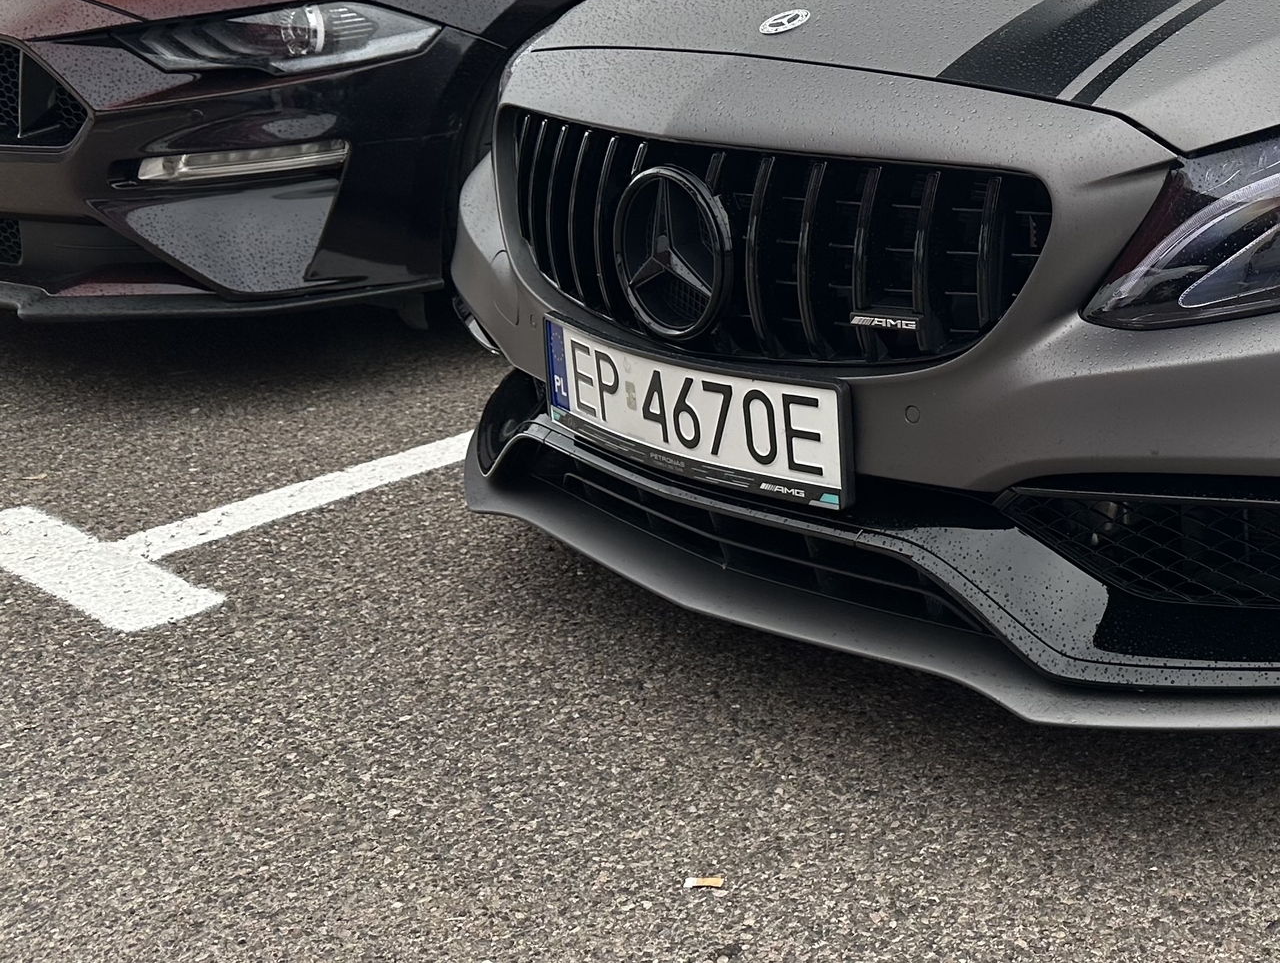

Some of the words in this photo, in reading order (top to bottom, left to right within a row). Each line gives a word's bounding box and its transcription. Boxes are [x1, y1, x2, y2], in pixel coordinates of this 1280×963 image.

[871, 317, 917, 330] AMG
[554, 374, 567, 398] PL
[570, 338, 620, 423] EP
[642, 369, 824, 477] 4670E
[649, 451, 686, 468] PETRONAS
[773, 485, 806, 498] AMG
